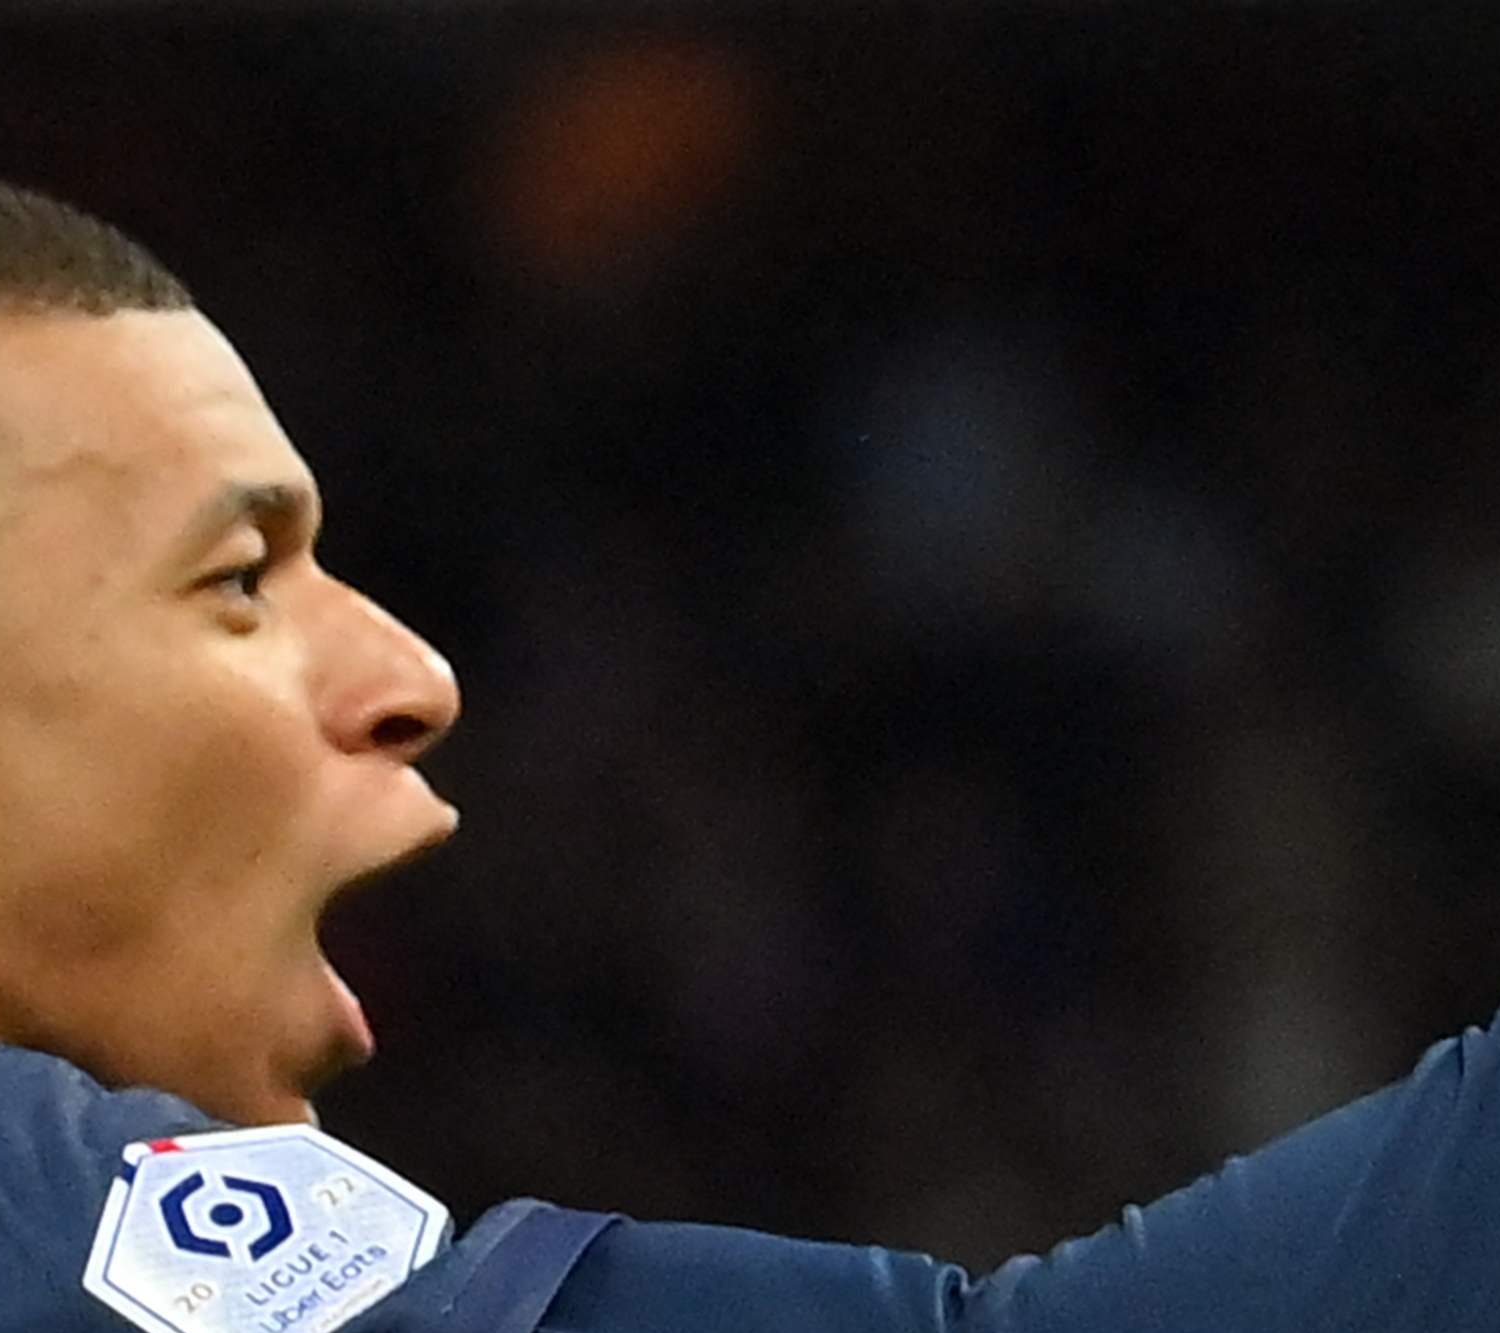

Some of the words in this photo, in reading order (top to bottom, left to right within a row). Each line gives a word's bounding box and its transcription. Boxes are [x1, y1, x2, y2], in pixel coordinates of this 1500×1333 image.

[246, 1243, 331, 1306] LIGUE
[329, 1229, 349, 1244] 1
[319, 1245, 388, 1292] Eats
[174, 1281, 215, 1315] 20
